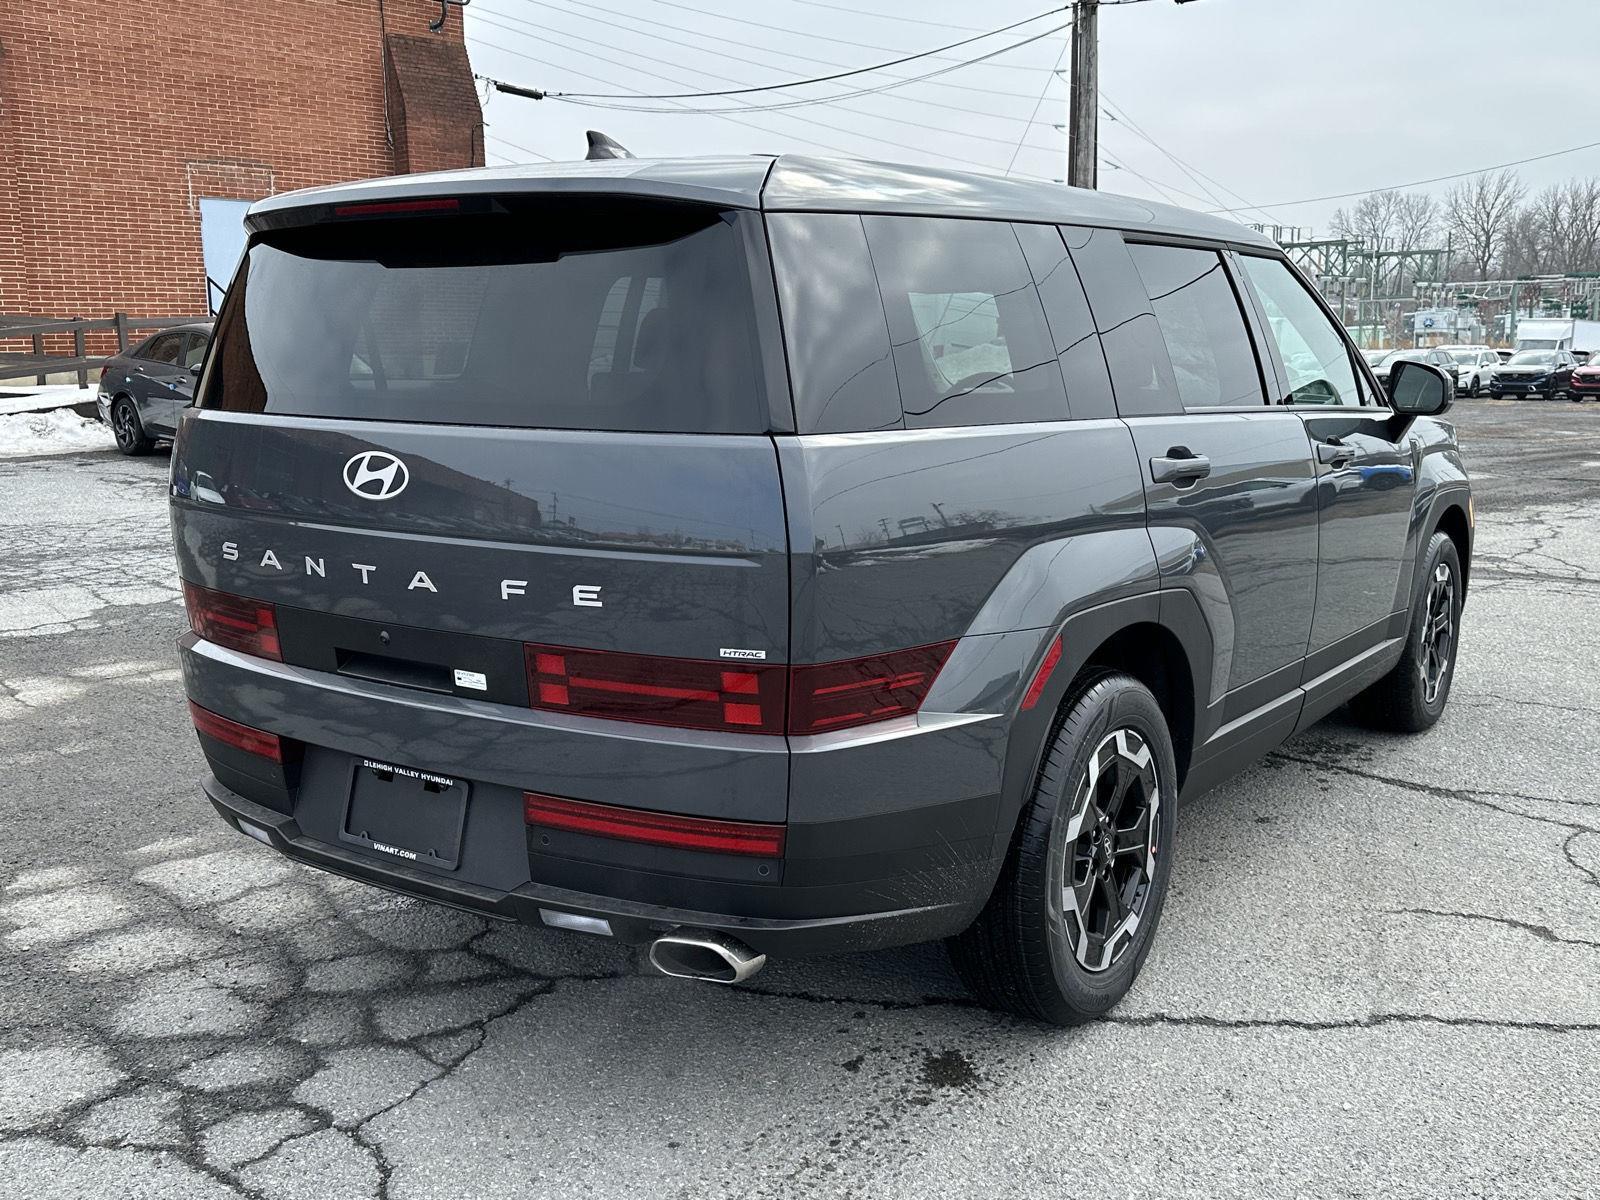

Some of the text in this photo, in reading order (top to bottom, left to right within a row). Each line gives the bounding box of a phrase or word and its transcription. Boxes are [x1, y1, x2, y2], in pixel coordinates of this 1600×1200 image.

[222, 541, 603, 608] SANTA FE
[723, 650, 762, 658] HTRAC
[369, 761, 453, 786] LEHIGH VALLEY HYUNDAI
[373, 842, 416, 860] VINART.COM
